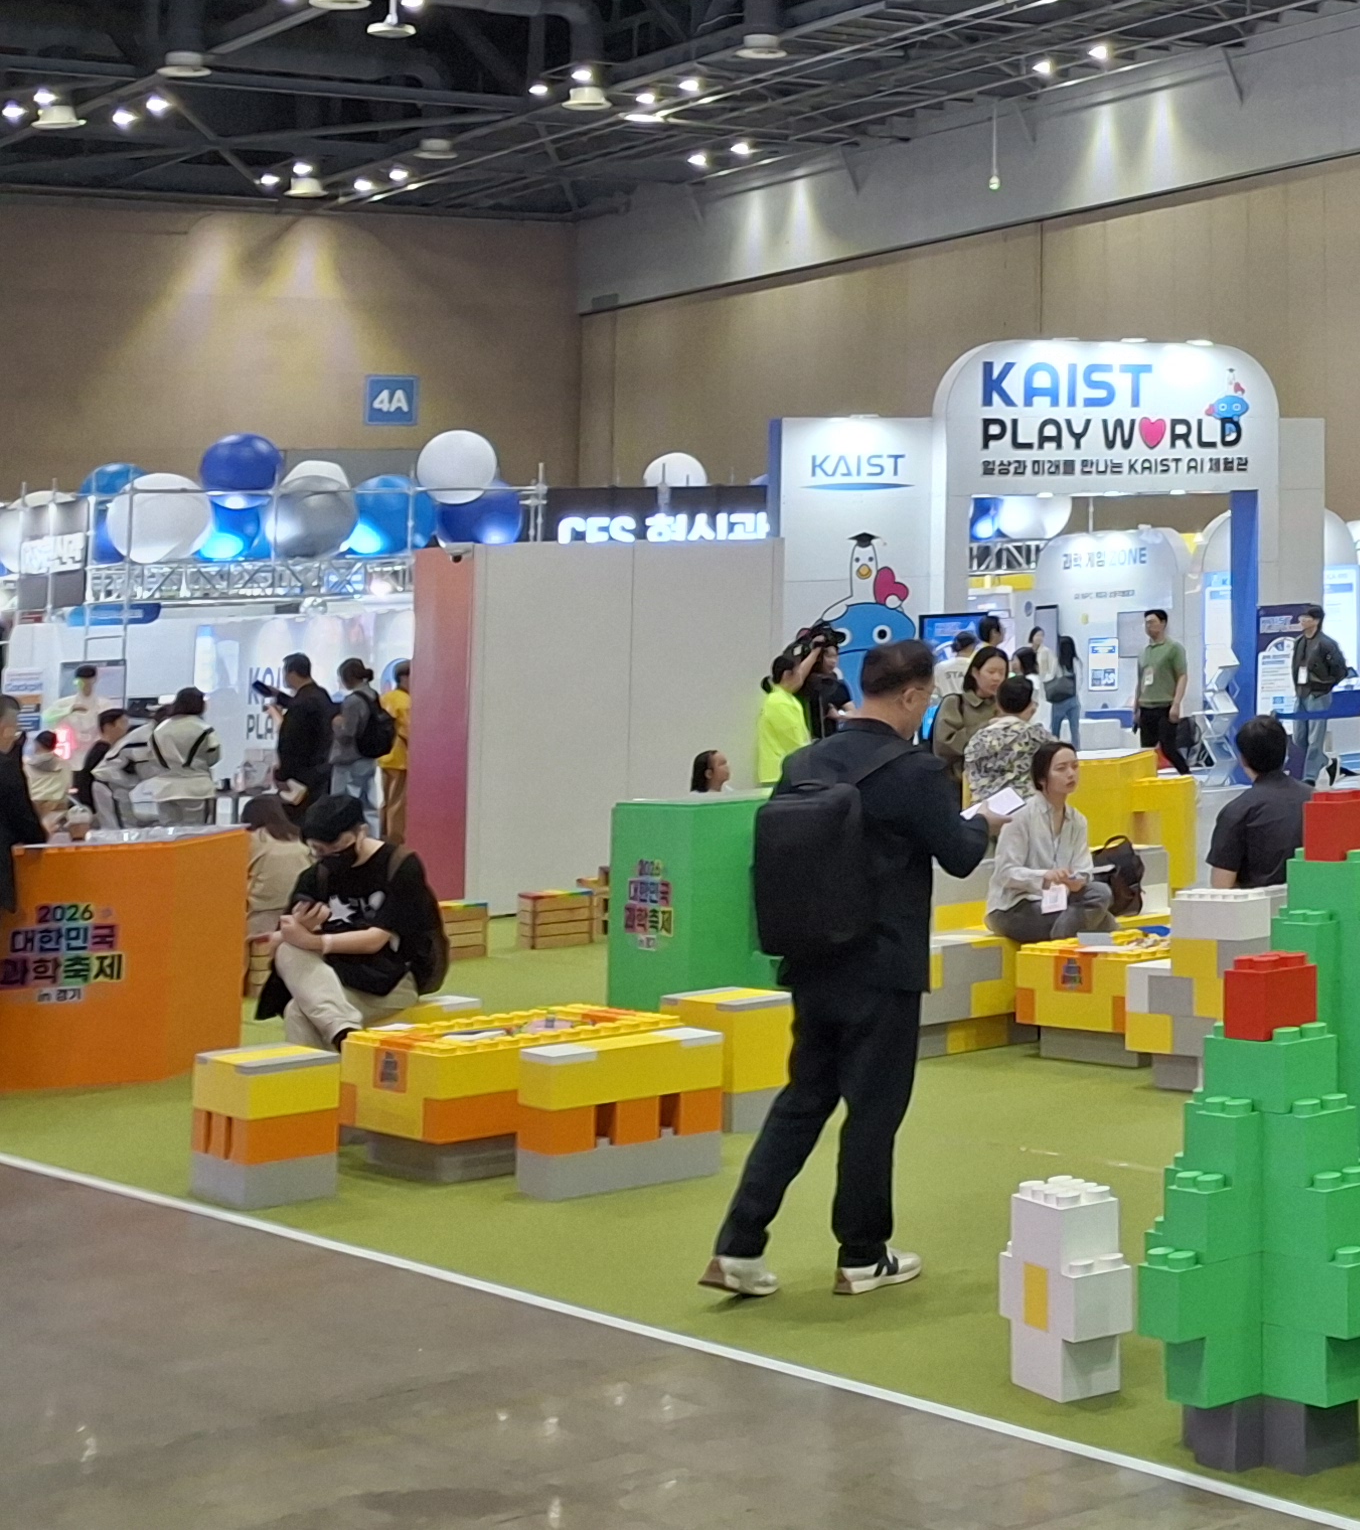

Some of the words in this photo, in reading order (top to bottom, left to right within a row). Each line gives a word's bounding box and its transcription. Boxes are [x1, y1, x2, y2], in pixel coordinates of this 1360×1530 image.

[981, 360, 1153, 408] KAIST
[372, 389, 409, 412] 4A
[980, 418, 1092, 450] PLAY
[810, 453, 906, 478] KAIST
[981, 459, 1028, 476] 일상과
[1031, 459, 1076, 476] 미래를
[1080, 458, 1124, 475] 만나는
[1127, 457, 1183, 475] KAIST
[1187, 457, 1205, 474] AI
[1208, 456, 1249, 473] 체험관
[1063, 553, 1083, 569] 과학
[1108, 547, 1148, 566] ZONE
[38, 903, 94, 924] 2026
[11, 924, 116, 953] 대한민국
[0, 953, 123, 986] 과학축제
